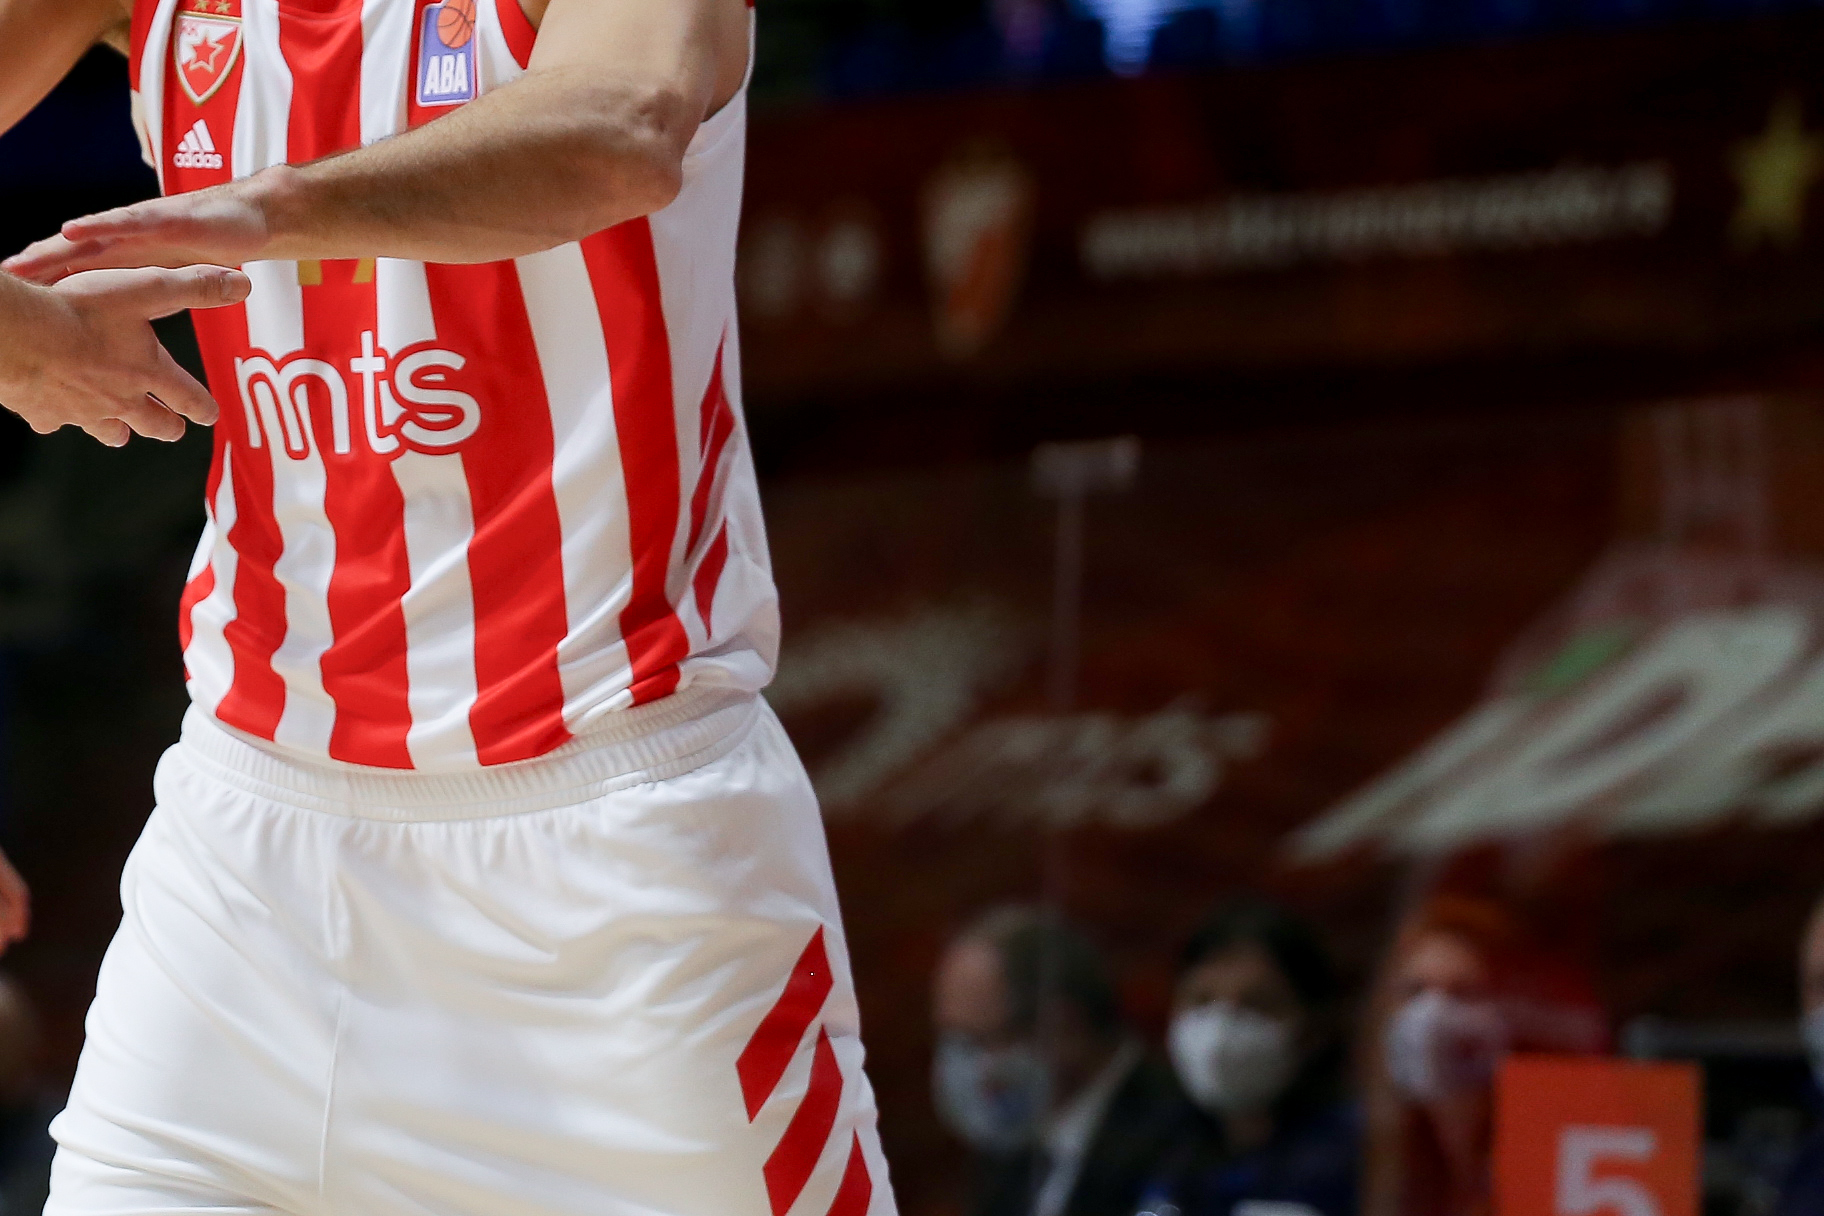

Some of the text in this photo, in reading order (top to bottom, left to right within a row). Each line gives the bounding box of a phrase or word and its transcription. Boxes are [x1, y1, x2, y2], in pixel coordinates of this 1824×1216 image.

[423, 51, 468, 96] ABA
[173, 150, 223, 170] adidas
[234, 331, 482, 455] mts
[1554, 1124, 1664, 1216] 5
